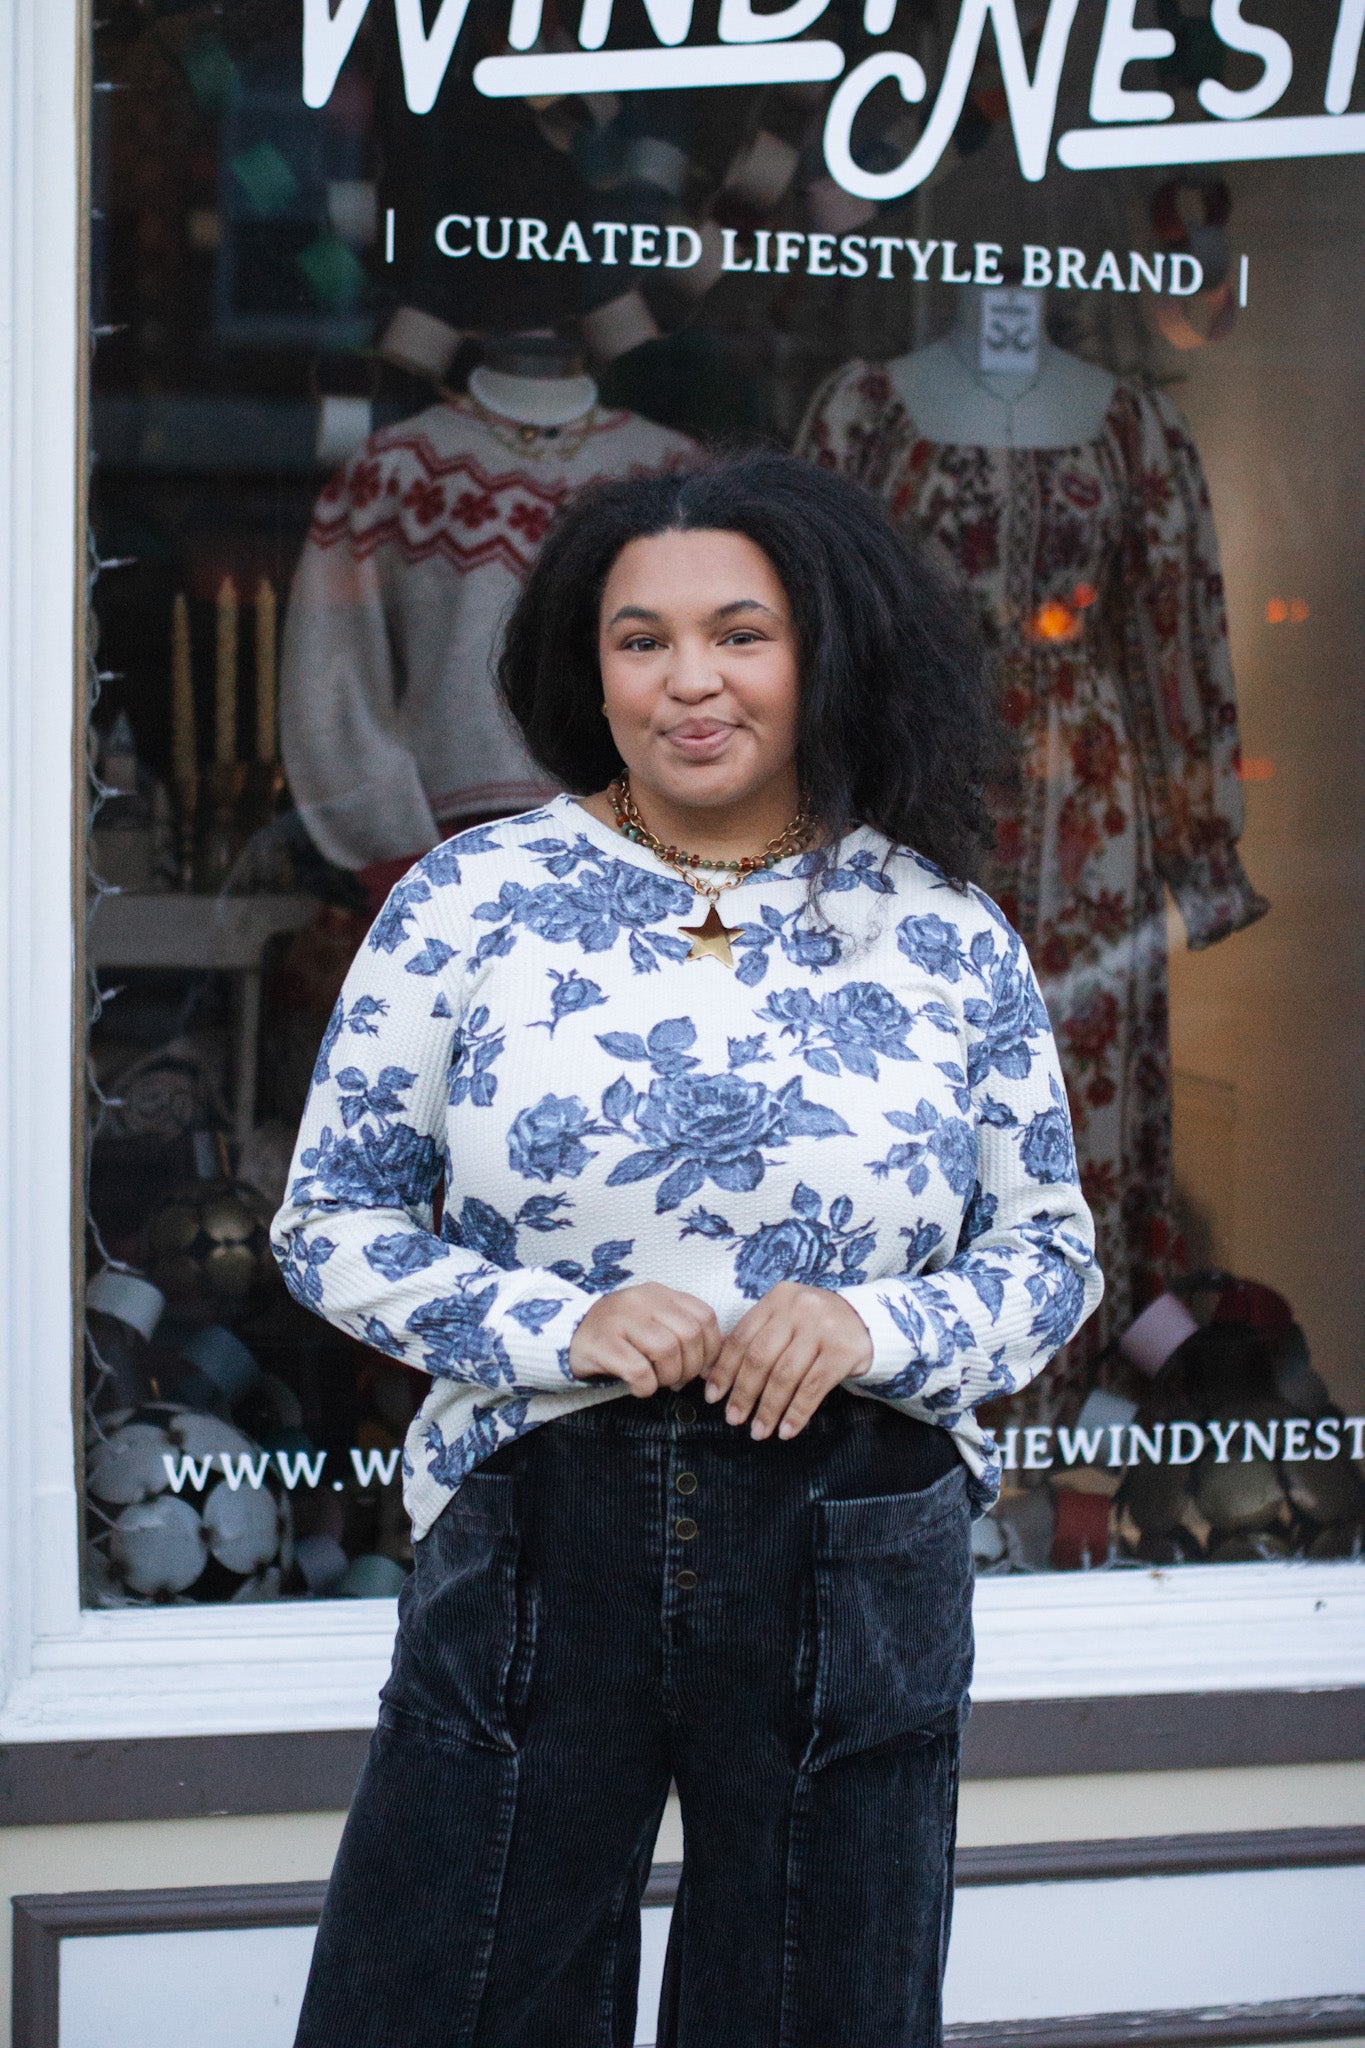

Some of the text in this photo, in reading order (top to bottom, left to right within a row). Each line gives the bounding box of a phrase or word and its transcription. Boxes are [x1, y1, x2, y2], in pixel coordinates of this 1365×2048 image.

[434, 214, 1204, 296] CURATED LIFESTYLE BRAND
